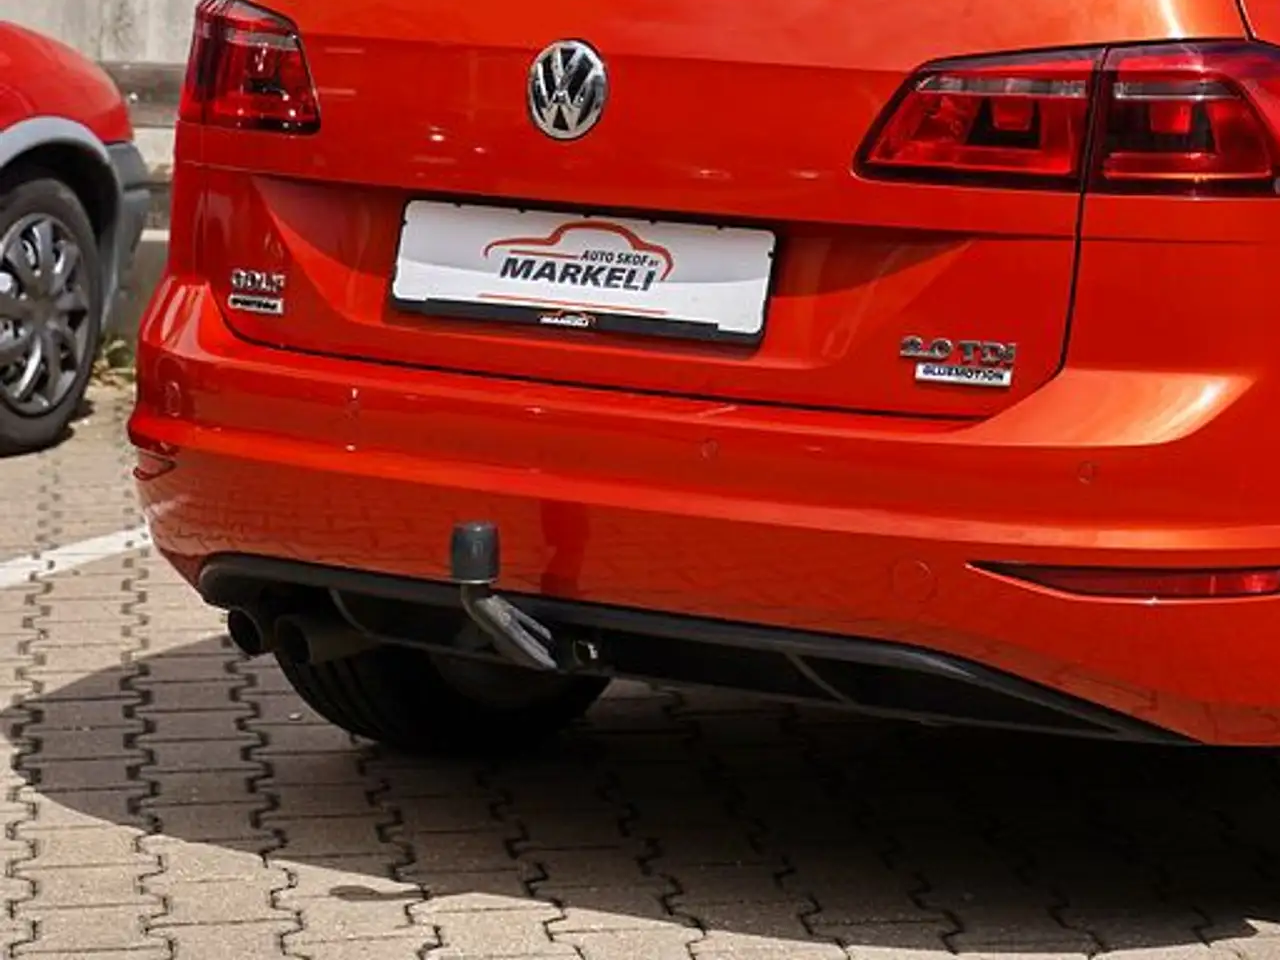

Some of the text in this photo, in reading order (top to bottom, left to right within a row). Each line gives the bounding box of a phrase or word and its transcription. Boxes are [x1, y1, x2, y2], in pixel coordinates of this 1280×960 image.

[580, 250, 614, 263] AUTO
[615, 254, 648, 267] SKOF
[500, 257, 656, 291] MARKELI
